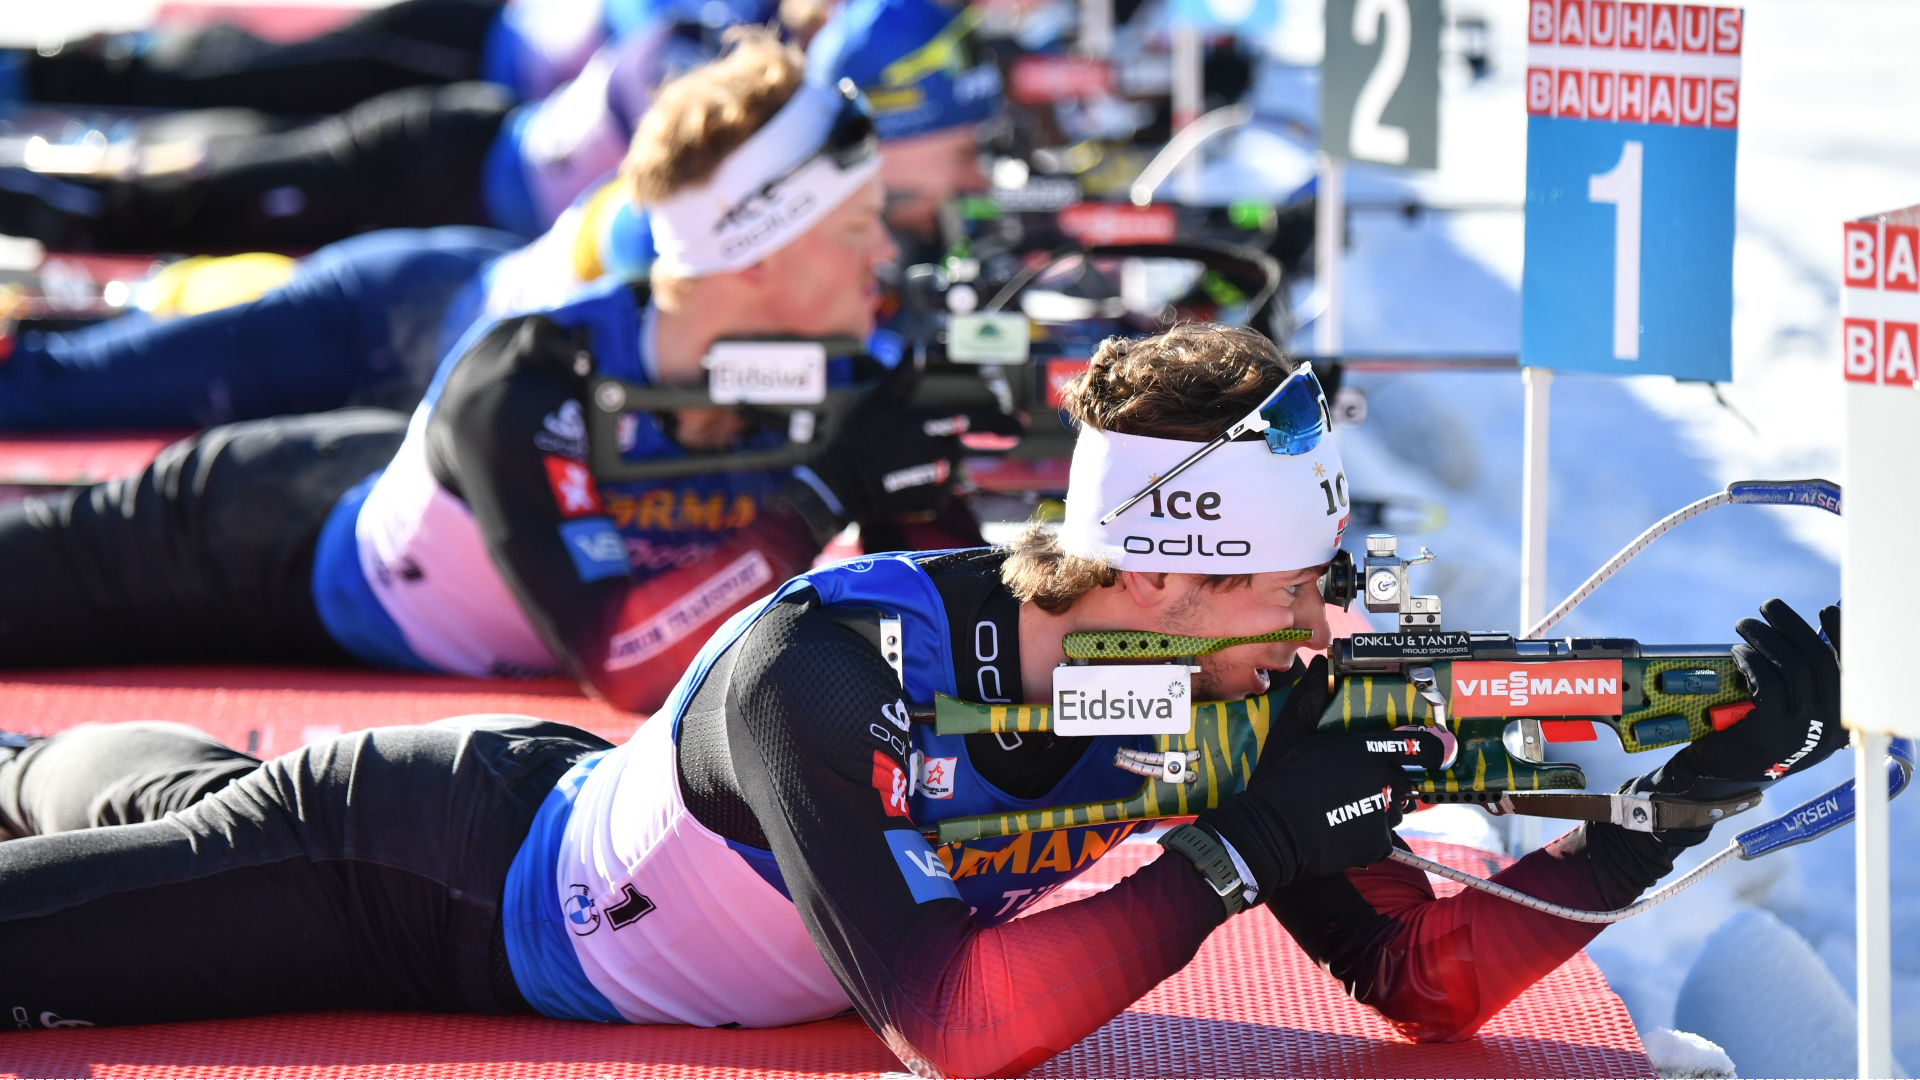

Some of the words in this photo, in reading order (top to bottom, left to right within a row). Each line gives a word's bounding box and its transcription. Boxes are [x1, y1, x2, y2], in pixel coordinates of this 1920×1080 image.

[1530, 1, 1739, 50] BAUHAUS
[1349, 0, 1412, 165] 2
[1529, 72, 1737, 122] BAUHAUS
[1588, 140, 1643, 361] 1
[1123, 534, 1252, 557] odlo
[1354, 636, 1404, 646] ONKL'U
[1407, 636, 1416, 646] &
[1418, 635, 1468, 646] TANT'A
[1058, 689, 1173, 720] Eidsiva
[1456, 670, 1617, 707] VIESSMANN
[603, 883, 657, 932] 1
